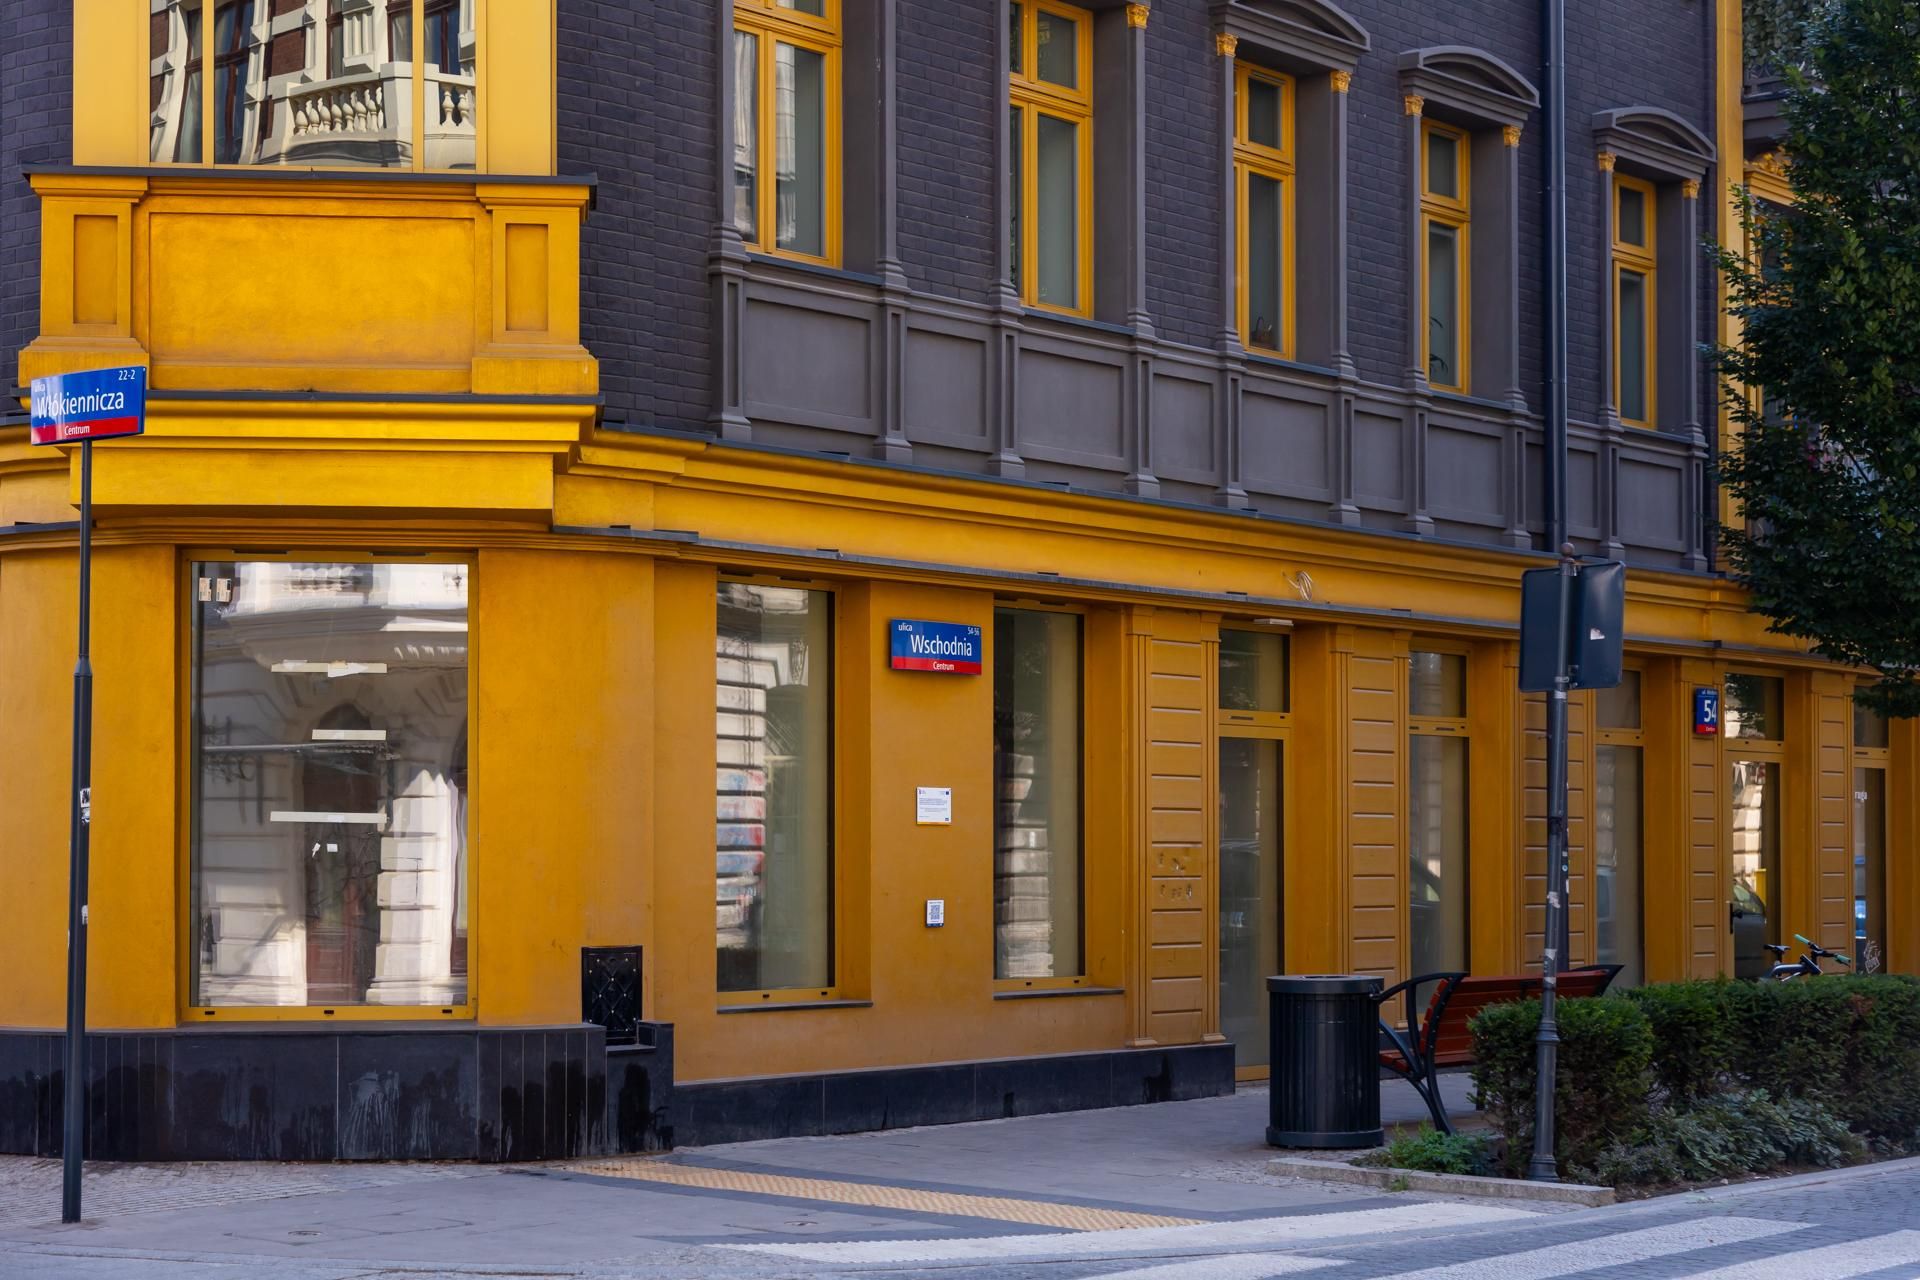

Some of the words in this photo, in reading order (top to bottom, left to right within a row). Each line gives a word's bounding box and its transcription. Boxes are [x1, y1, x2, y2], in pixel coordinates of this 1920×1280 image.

[118, 369, 136, 381] 22-2
[37, 388, 124, 419] Włókiennicza
[64, 425, 90, 436] Centrum
[898, 622, 912, 632] ulica
[910, 634, 972, 656] Wschodnia
[932, 661, 955, 671] Centrum
[1703, 699, 1717, 724] 54
